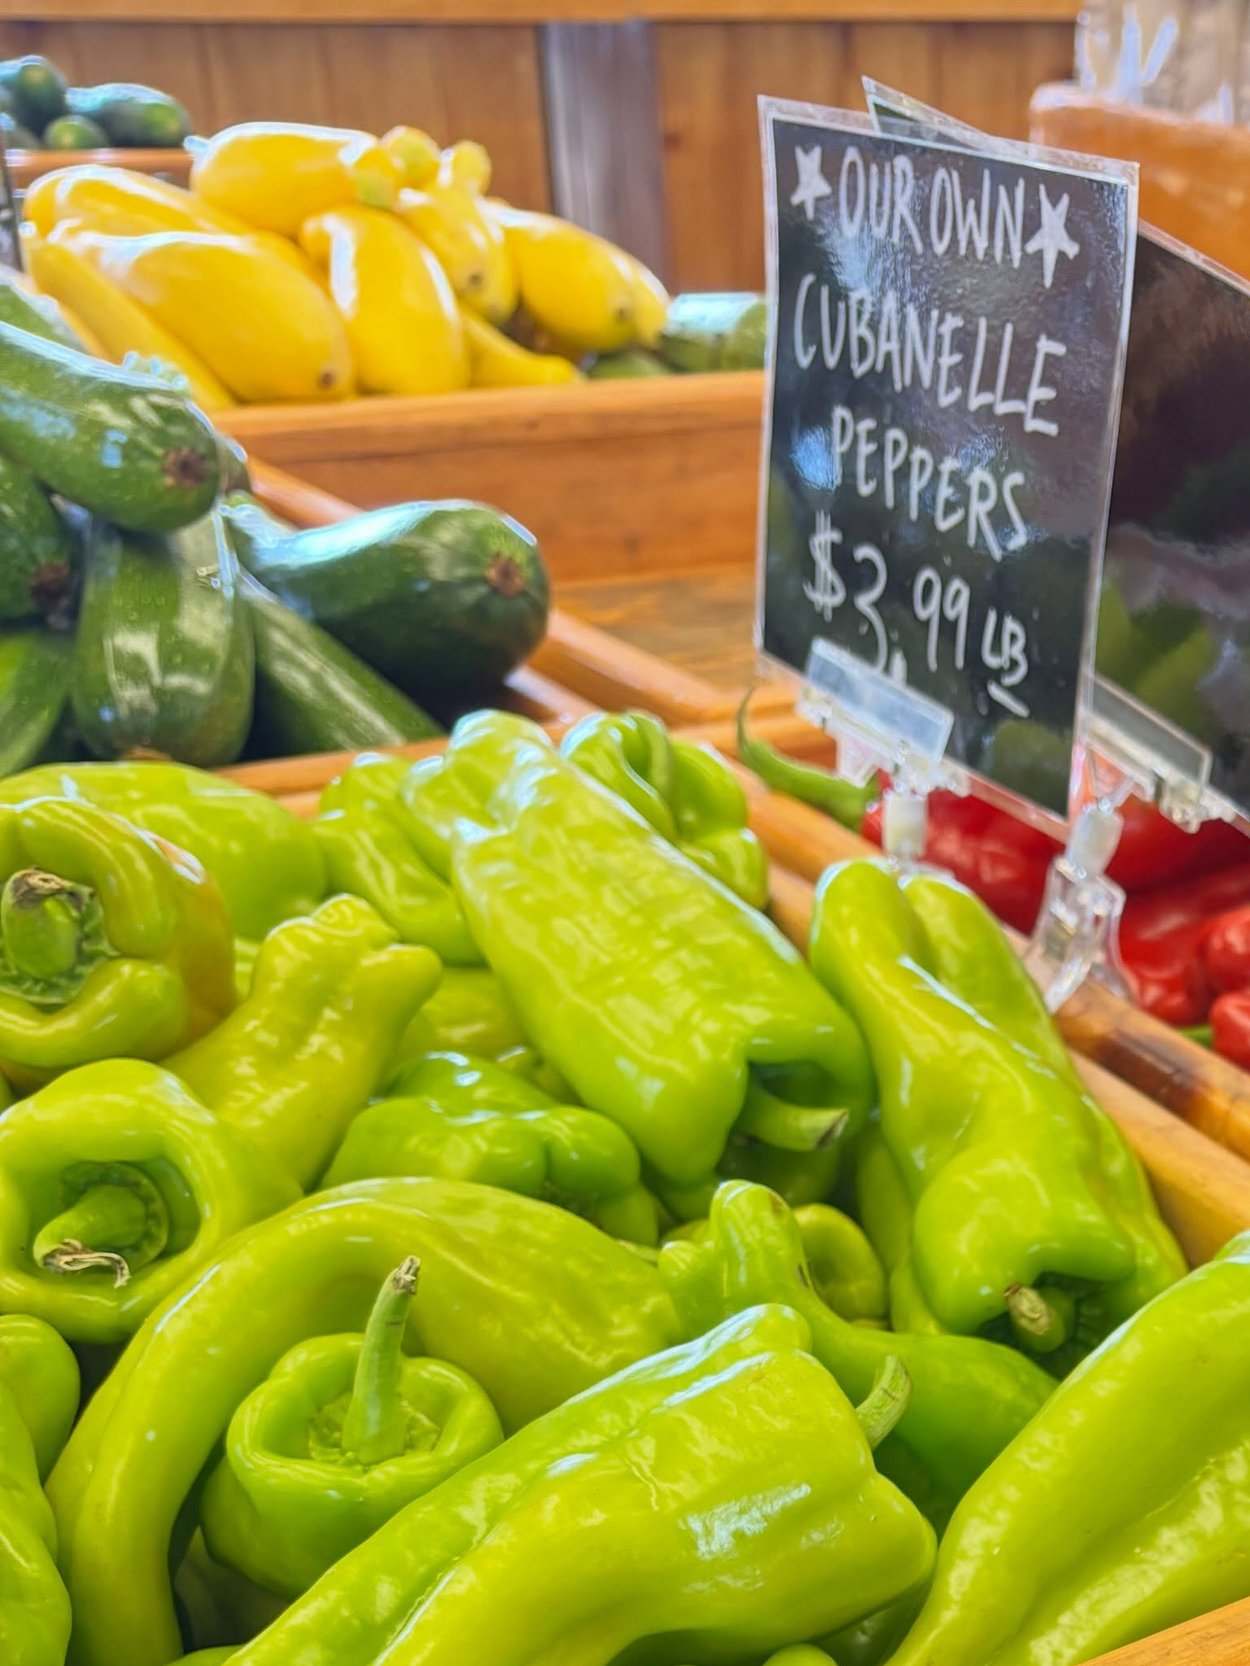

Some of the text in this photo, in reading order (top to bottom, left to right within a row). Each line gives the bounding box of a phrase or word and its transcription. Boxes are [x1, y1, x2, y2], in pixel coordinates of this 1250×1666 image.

[838, 146, 1025, 269] OUR OWN
[793, 272, 1068, 438] CUBANELLE
[830, 403, 1029, 563] PEPPERS
[981, 606, 1029, 687] LB
